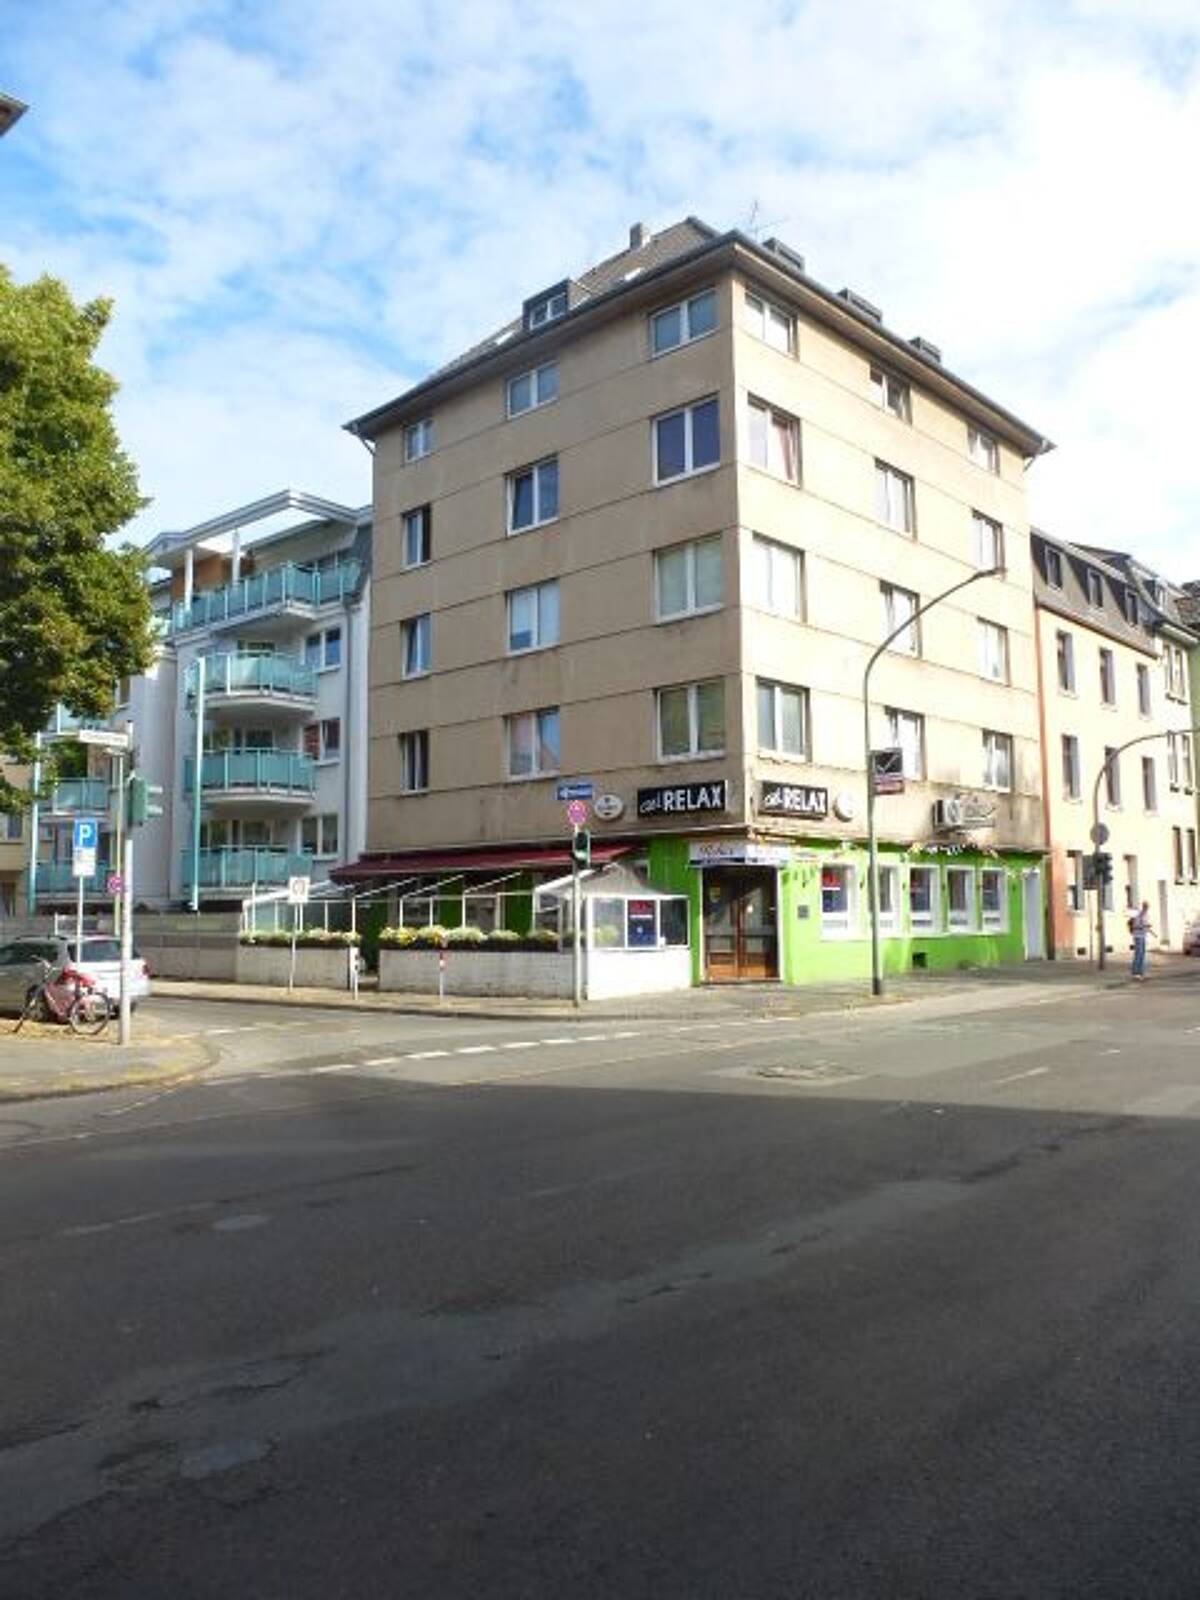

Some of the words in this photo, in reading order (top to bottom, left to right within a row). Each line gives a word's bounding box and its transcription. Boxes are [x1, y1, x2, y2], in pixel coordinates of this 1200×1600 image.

[664, 786, 721, 811] RELAX
[783, 787, 826, 813] RELAX
[80, 825, 91, 845] P
